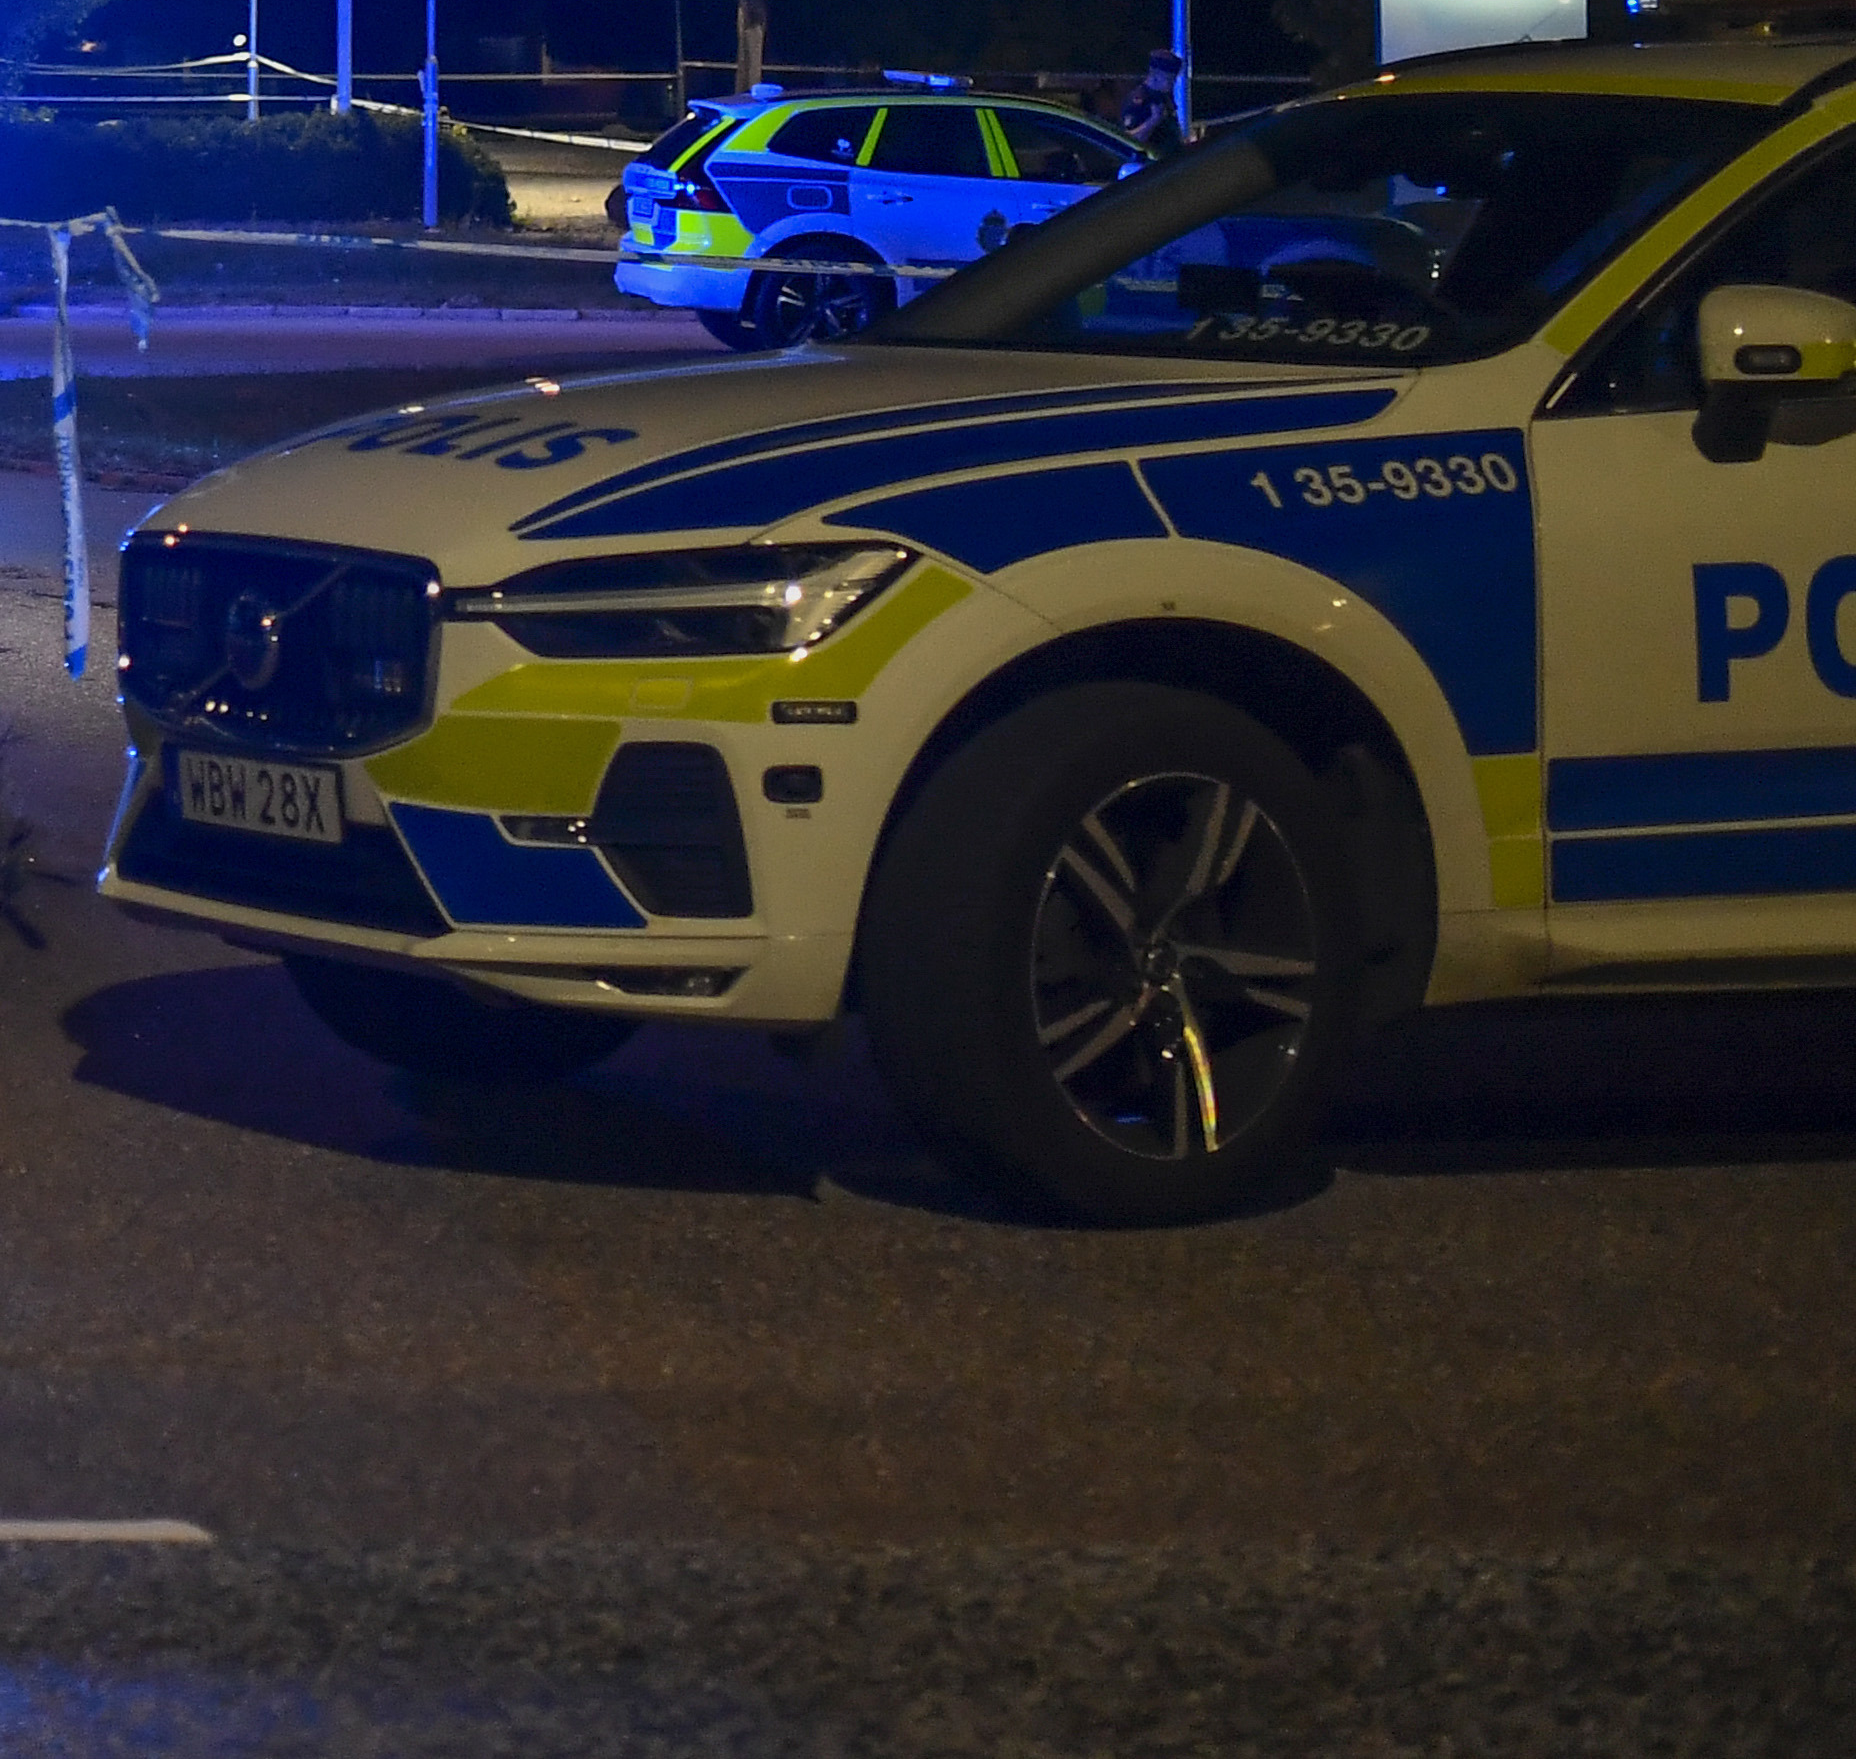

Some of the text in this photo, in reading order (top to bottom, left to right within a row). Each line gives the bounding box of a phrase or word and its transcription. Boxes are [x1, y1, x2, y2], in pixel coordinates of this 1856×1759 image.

[1187, 316, 1431, 351] 1 35-9330
[1250, 452, 1518, 509] 1 35-9330
[188, 757, 325, 833] WBW 28X
